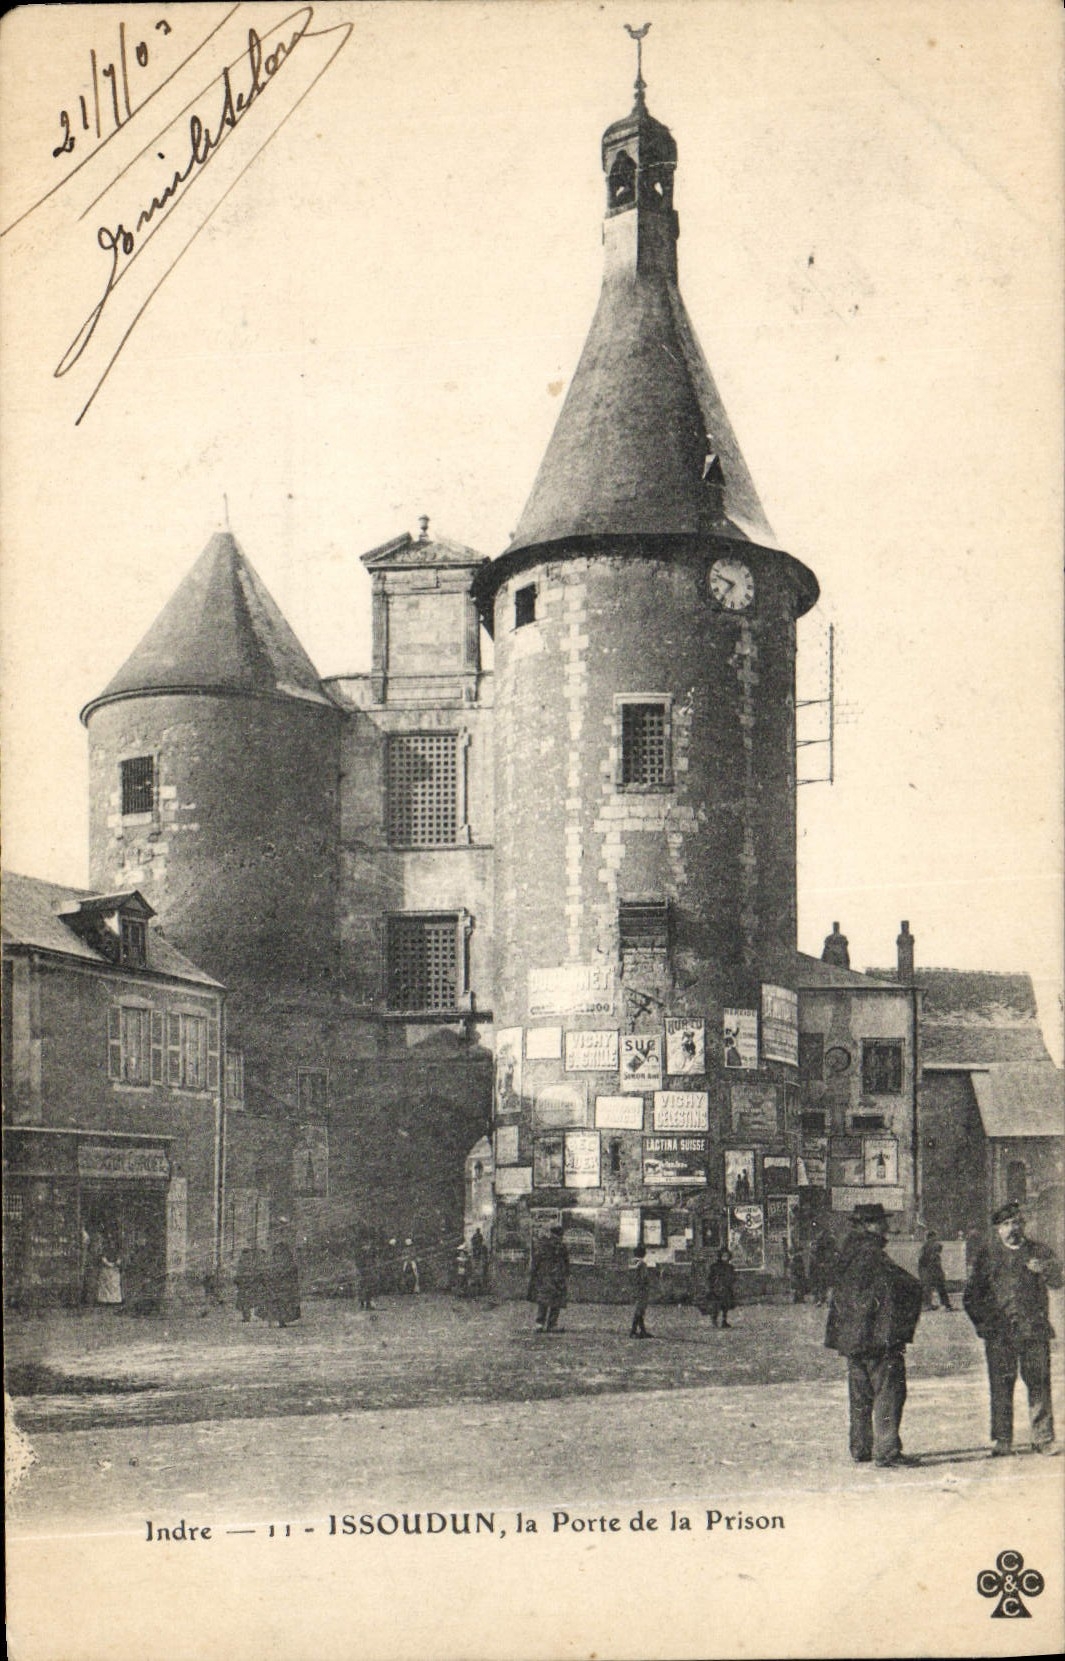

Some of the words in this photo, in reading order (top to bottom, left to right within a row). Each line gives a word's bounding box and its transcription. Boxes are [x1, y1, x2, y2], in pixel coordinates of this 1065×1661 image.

[572, 1034, 612, 1048] VICHY
[661, 1094, 704, 1108] VICHY
[646, 1138, 678, 1151] LACTINA
[680, 1138, 706, 1151] SUISSE
